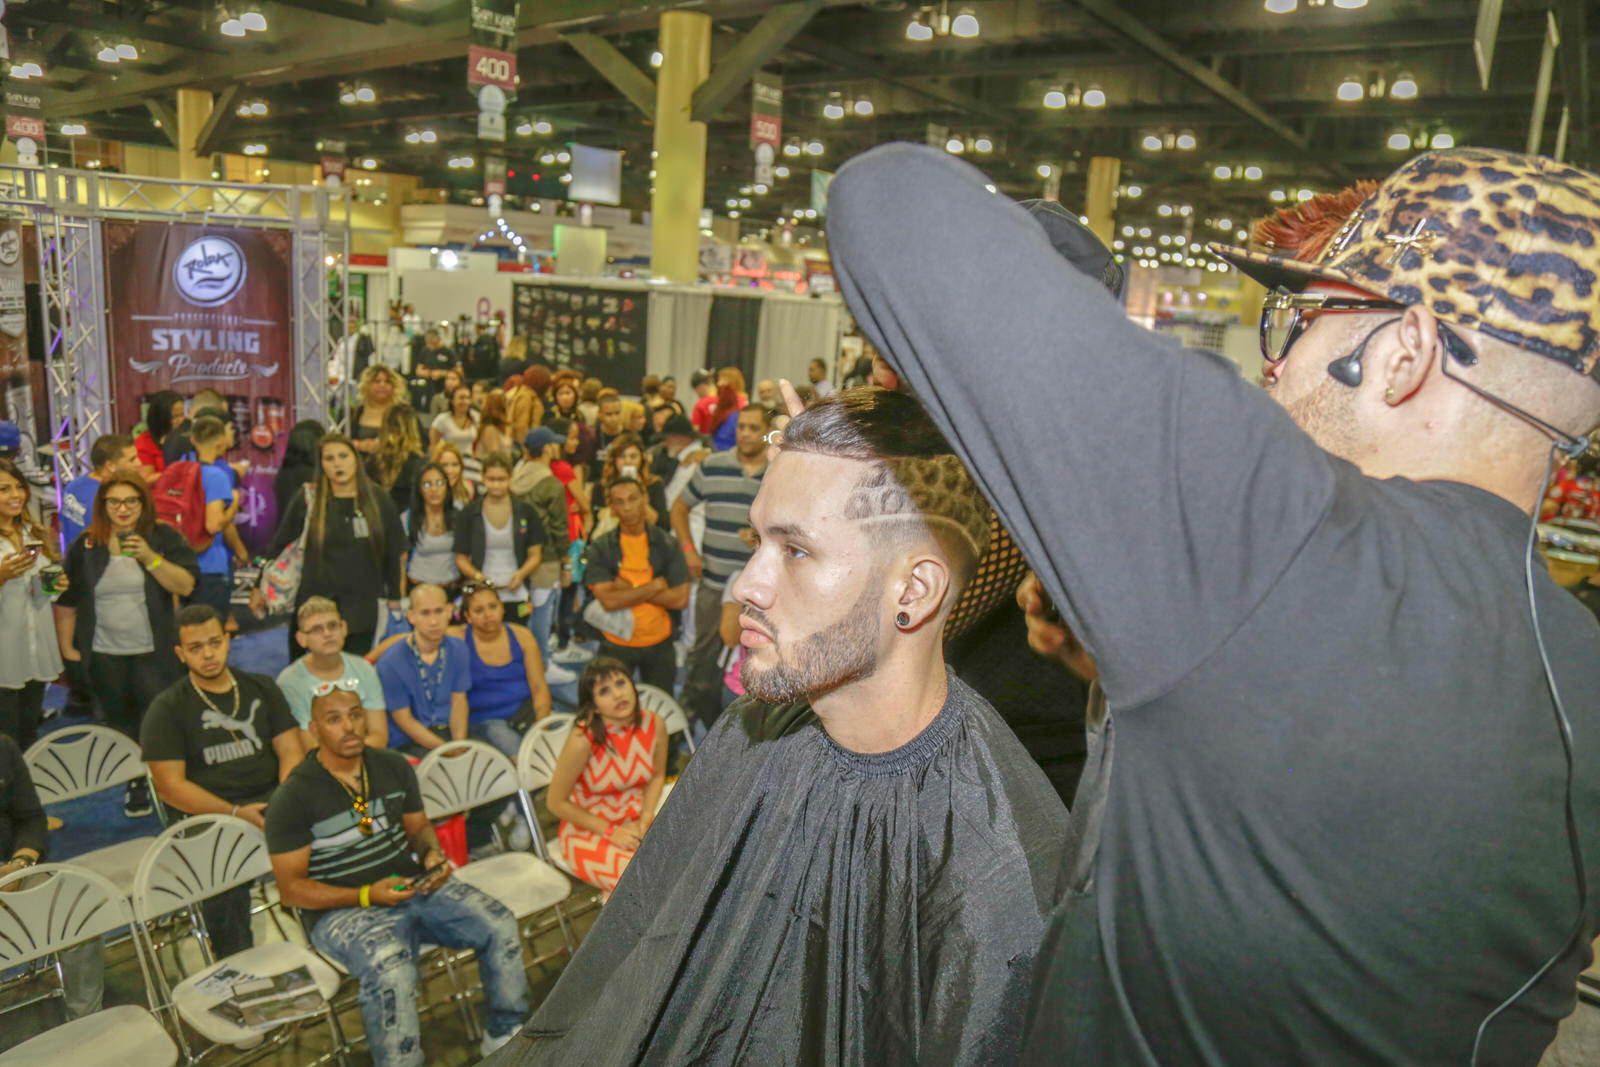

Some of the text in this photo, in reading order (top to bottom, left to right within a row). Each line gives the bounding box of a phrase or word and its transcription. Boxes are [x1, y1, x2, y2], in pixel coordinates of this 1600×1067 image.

[476, 57, 510, 81] 400
[151, 328, 260, 354] STYLING
[168, 354, 249, 378] Products
[203, 739, 255, 765] PUMA
